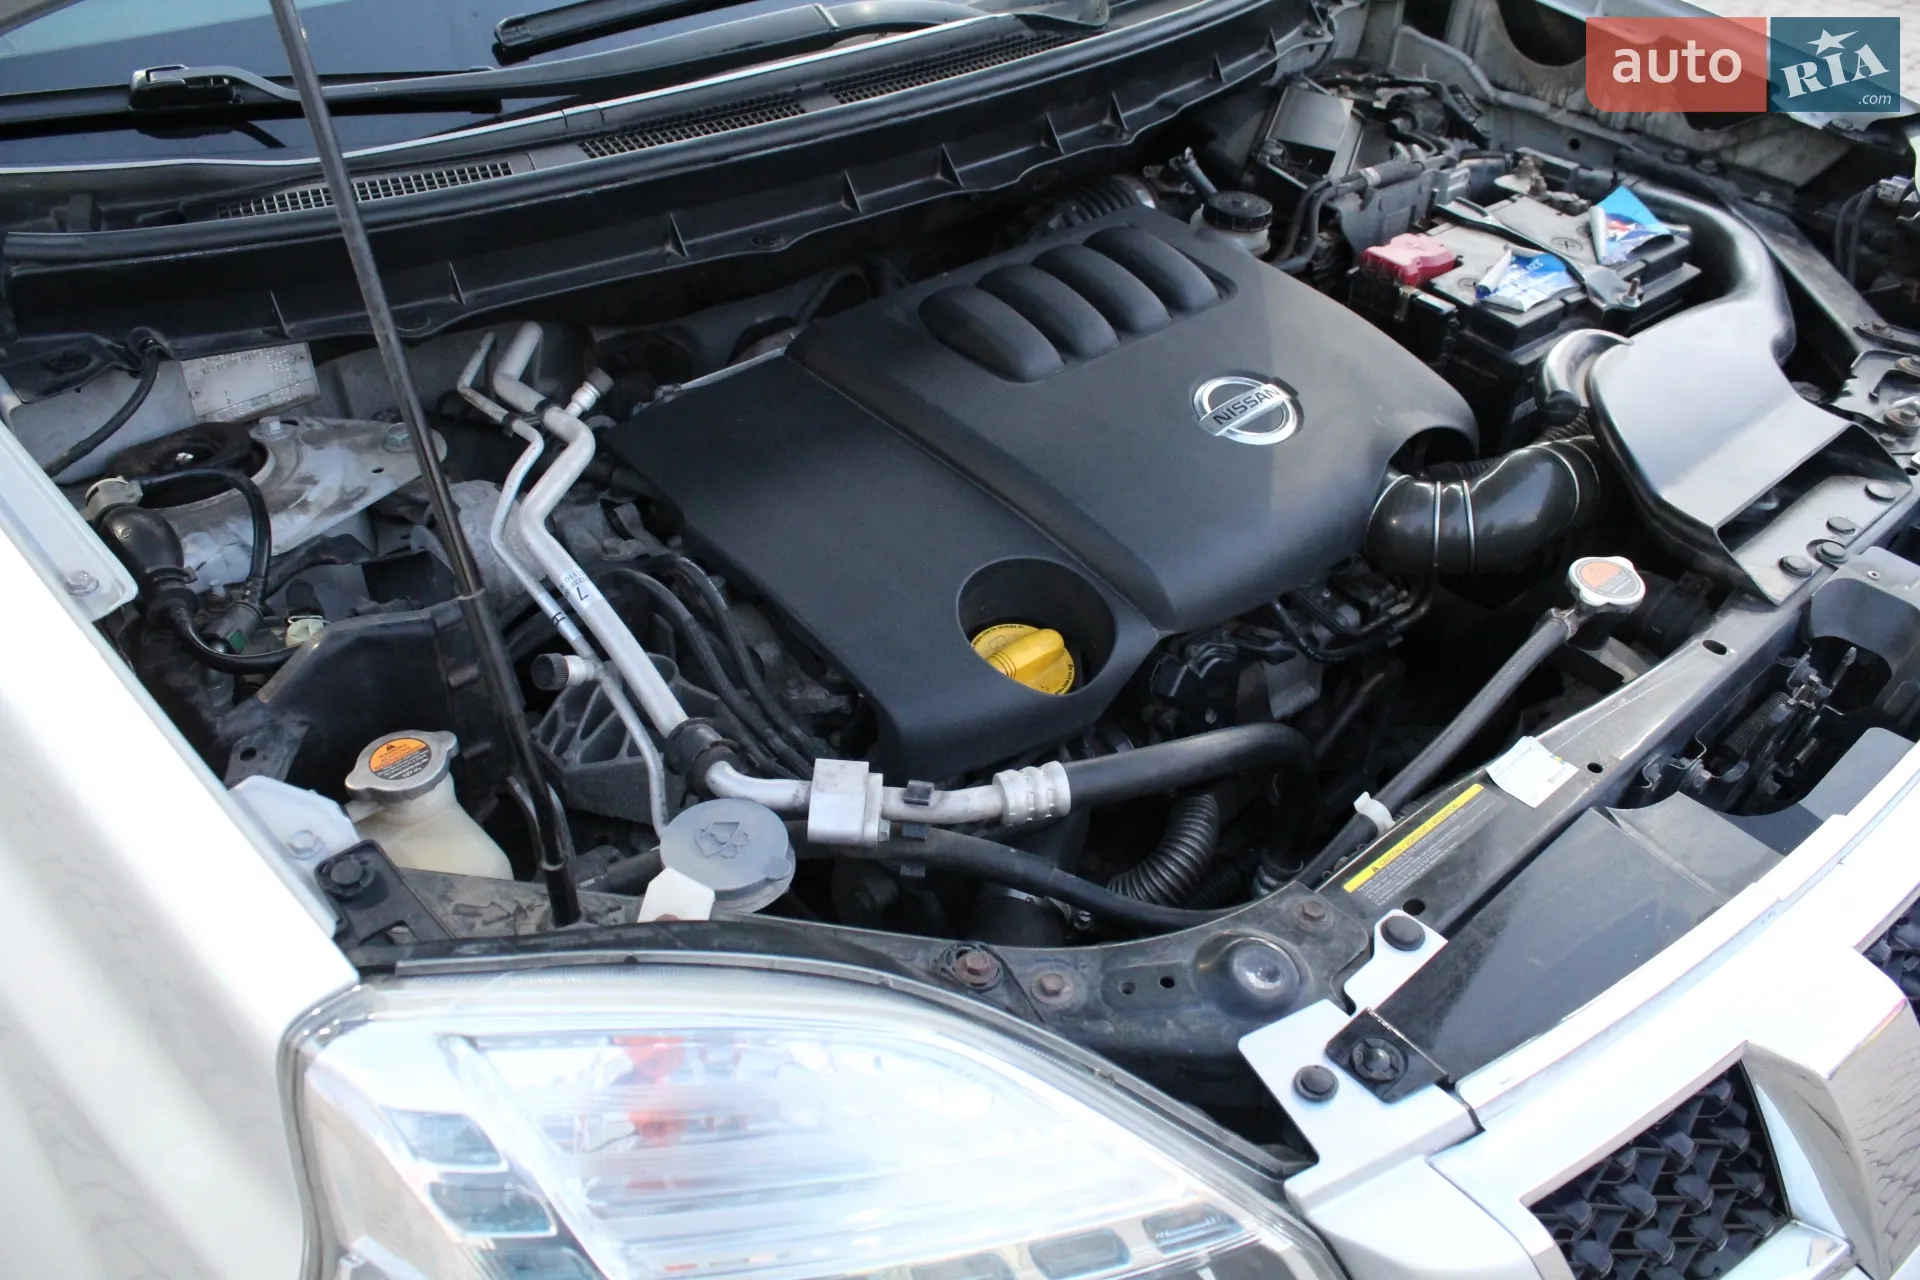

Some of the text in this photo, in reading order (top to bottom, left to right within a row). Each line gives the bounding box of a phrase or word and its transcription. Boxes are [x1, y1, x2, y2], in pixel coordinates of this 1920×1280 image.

[1212, 388, 1281, 425] NISSAN
[1378, 845, 1402, 866] CAUTION
[1431, 802, 1458, 825] ATTENTION
